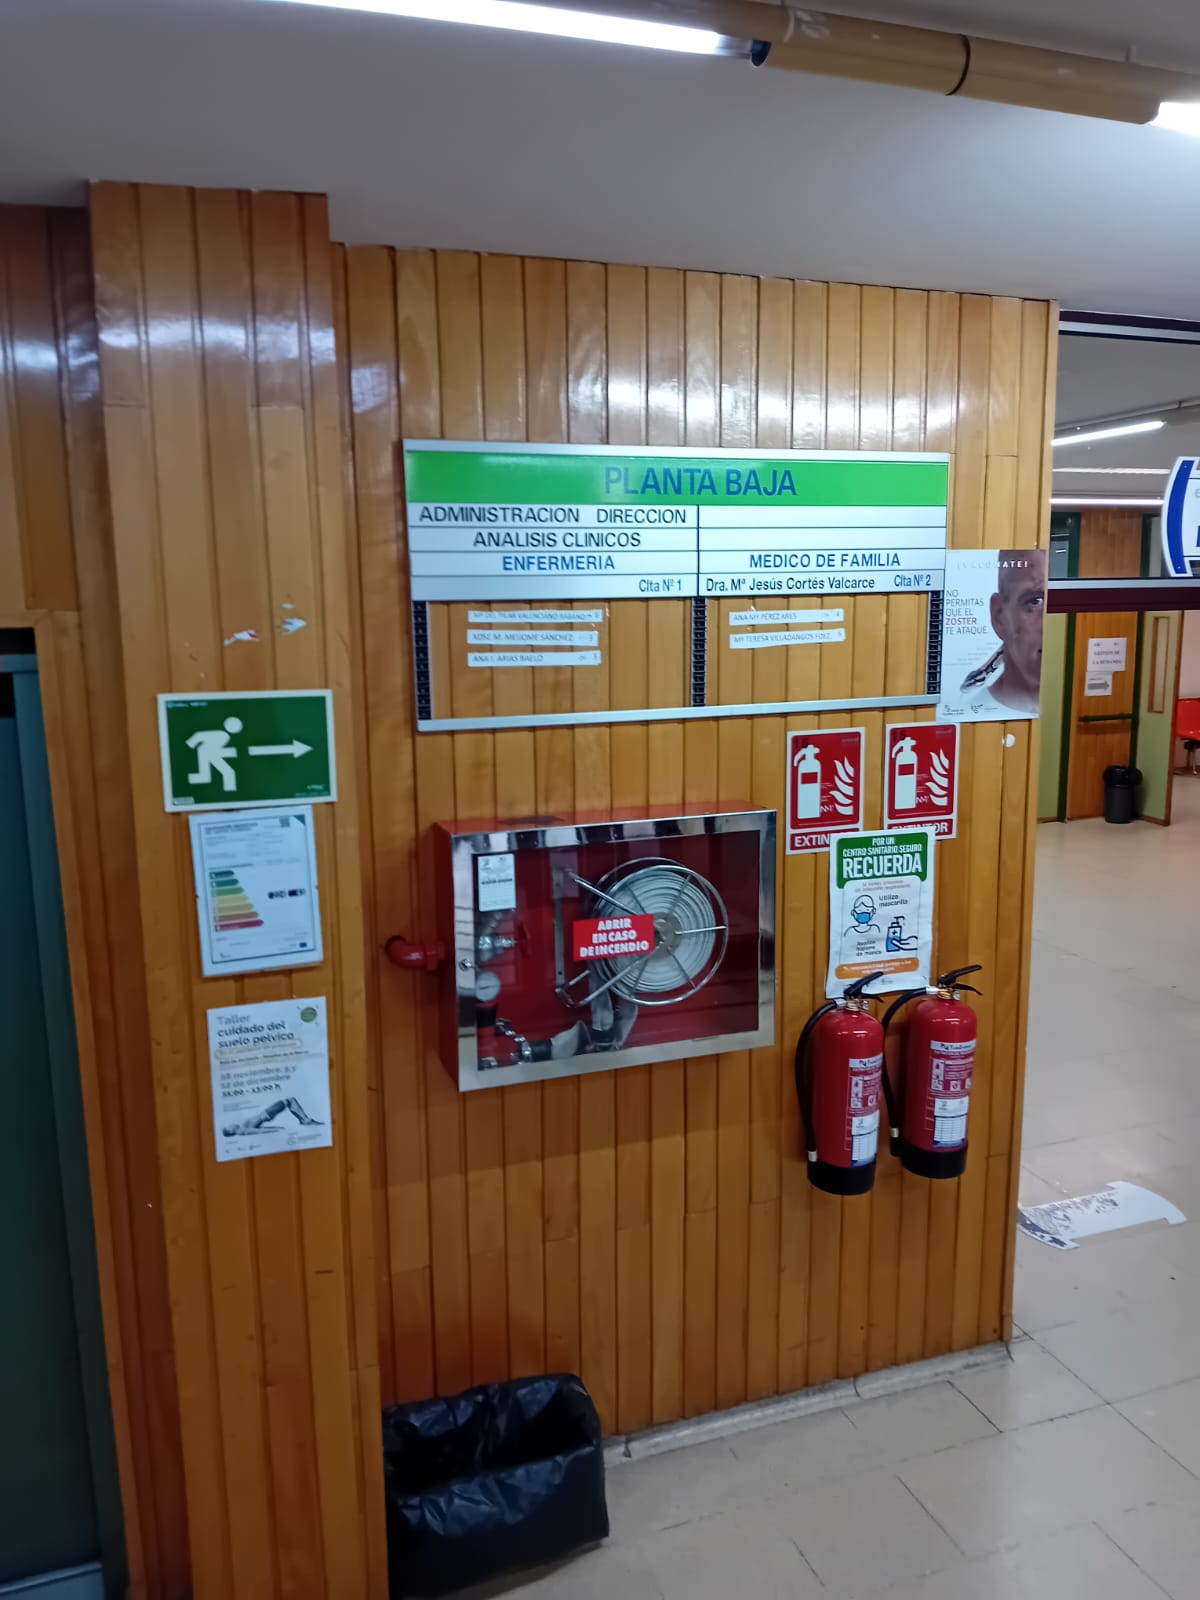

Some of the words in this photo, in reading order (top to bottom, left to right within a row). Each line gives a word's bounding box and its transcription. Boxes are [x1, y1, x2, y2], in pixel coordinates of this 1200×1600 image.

[605, 467, 718, 495] PLANTA
[726, 469, 797, 496] BAJA
[419, 506, 580, 523] ADMINISTRACION
[596, 508, 686, 524] DIRECCION
[473, 532, 557, 547] ANALISIS
[562, 532, 641, 547] CLINICOS
[502, 555, 616, 571] ENFERMERIA
[750, 554, 810, 568] MEDICO
[816, 554, 836, 567] DE
[841, 553, 901, 567] FAMILIA
[677, 579, 681, 591] 1
[706, 578, 728, 591] Dra.
[731, 578, 746, 591] Mª
[749, 577, 783, 590] Jesús
[786, 576, 825, 589] Cortés
[828, 577, 875, 589] Valcarce
[925, 574, 931, 586] 2
[946, 589, 959, 598] NO
[945, 599, 984, 607] PERMITAS
[945, 608, 963, 616] QUE
[964, 608, 973, 616] EL
[945, 617, 977, 625] ZOSTER
[946, 627, 955, 635] TE
[957, 626, 989, 635] ATAQUE
[794, 835, 830, 848] EXTIN
[872, 838, 885, 846] POR
[885, 837, 895, 845] UN
[843, 848, 866, 857] CENTRO
[867, 846, 898, 855] SANITARIO
[899, 844, 922, 852] SEGURO
[843, 853, 922, 878] RECUERDA
[597, 918, 632, 931] ABRIR
[592, 932, 607, 943] EN
[608, 929, 637, 942] CASO
[579, 946, 594, 957] DE
[595, 940, 649, 955] INCENDIO
[216, 1015, 250, 1025] Taller
[217, 1024, 264, 1037] cuidado
[266, 1020, 286, 1031] del
[217, 1036, 250, 1048] suelo
